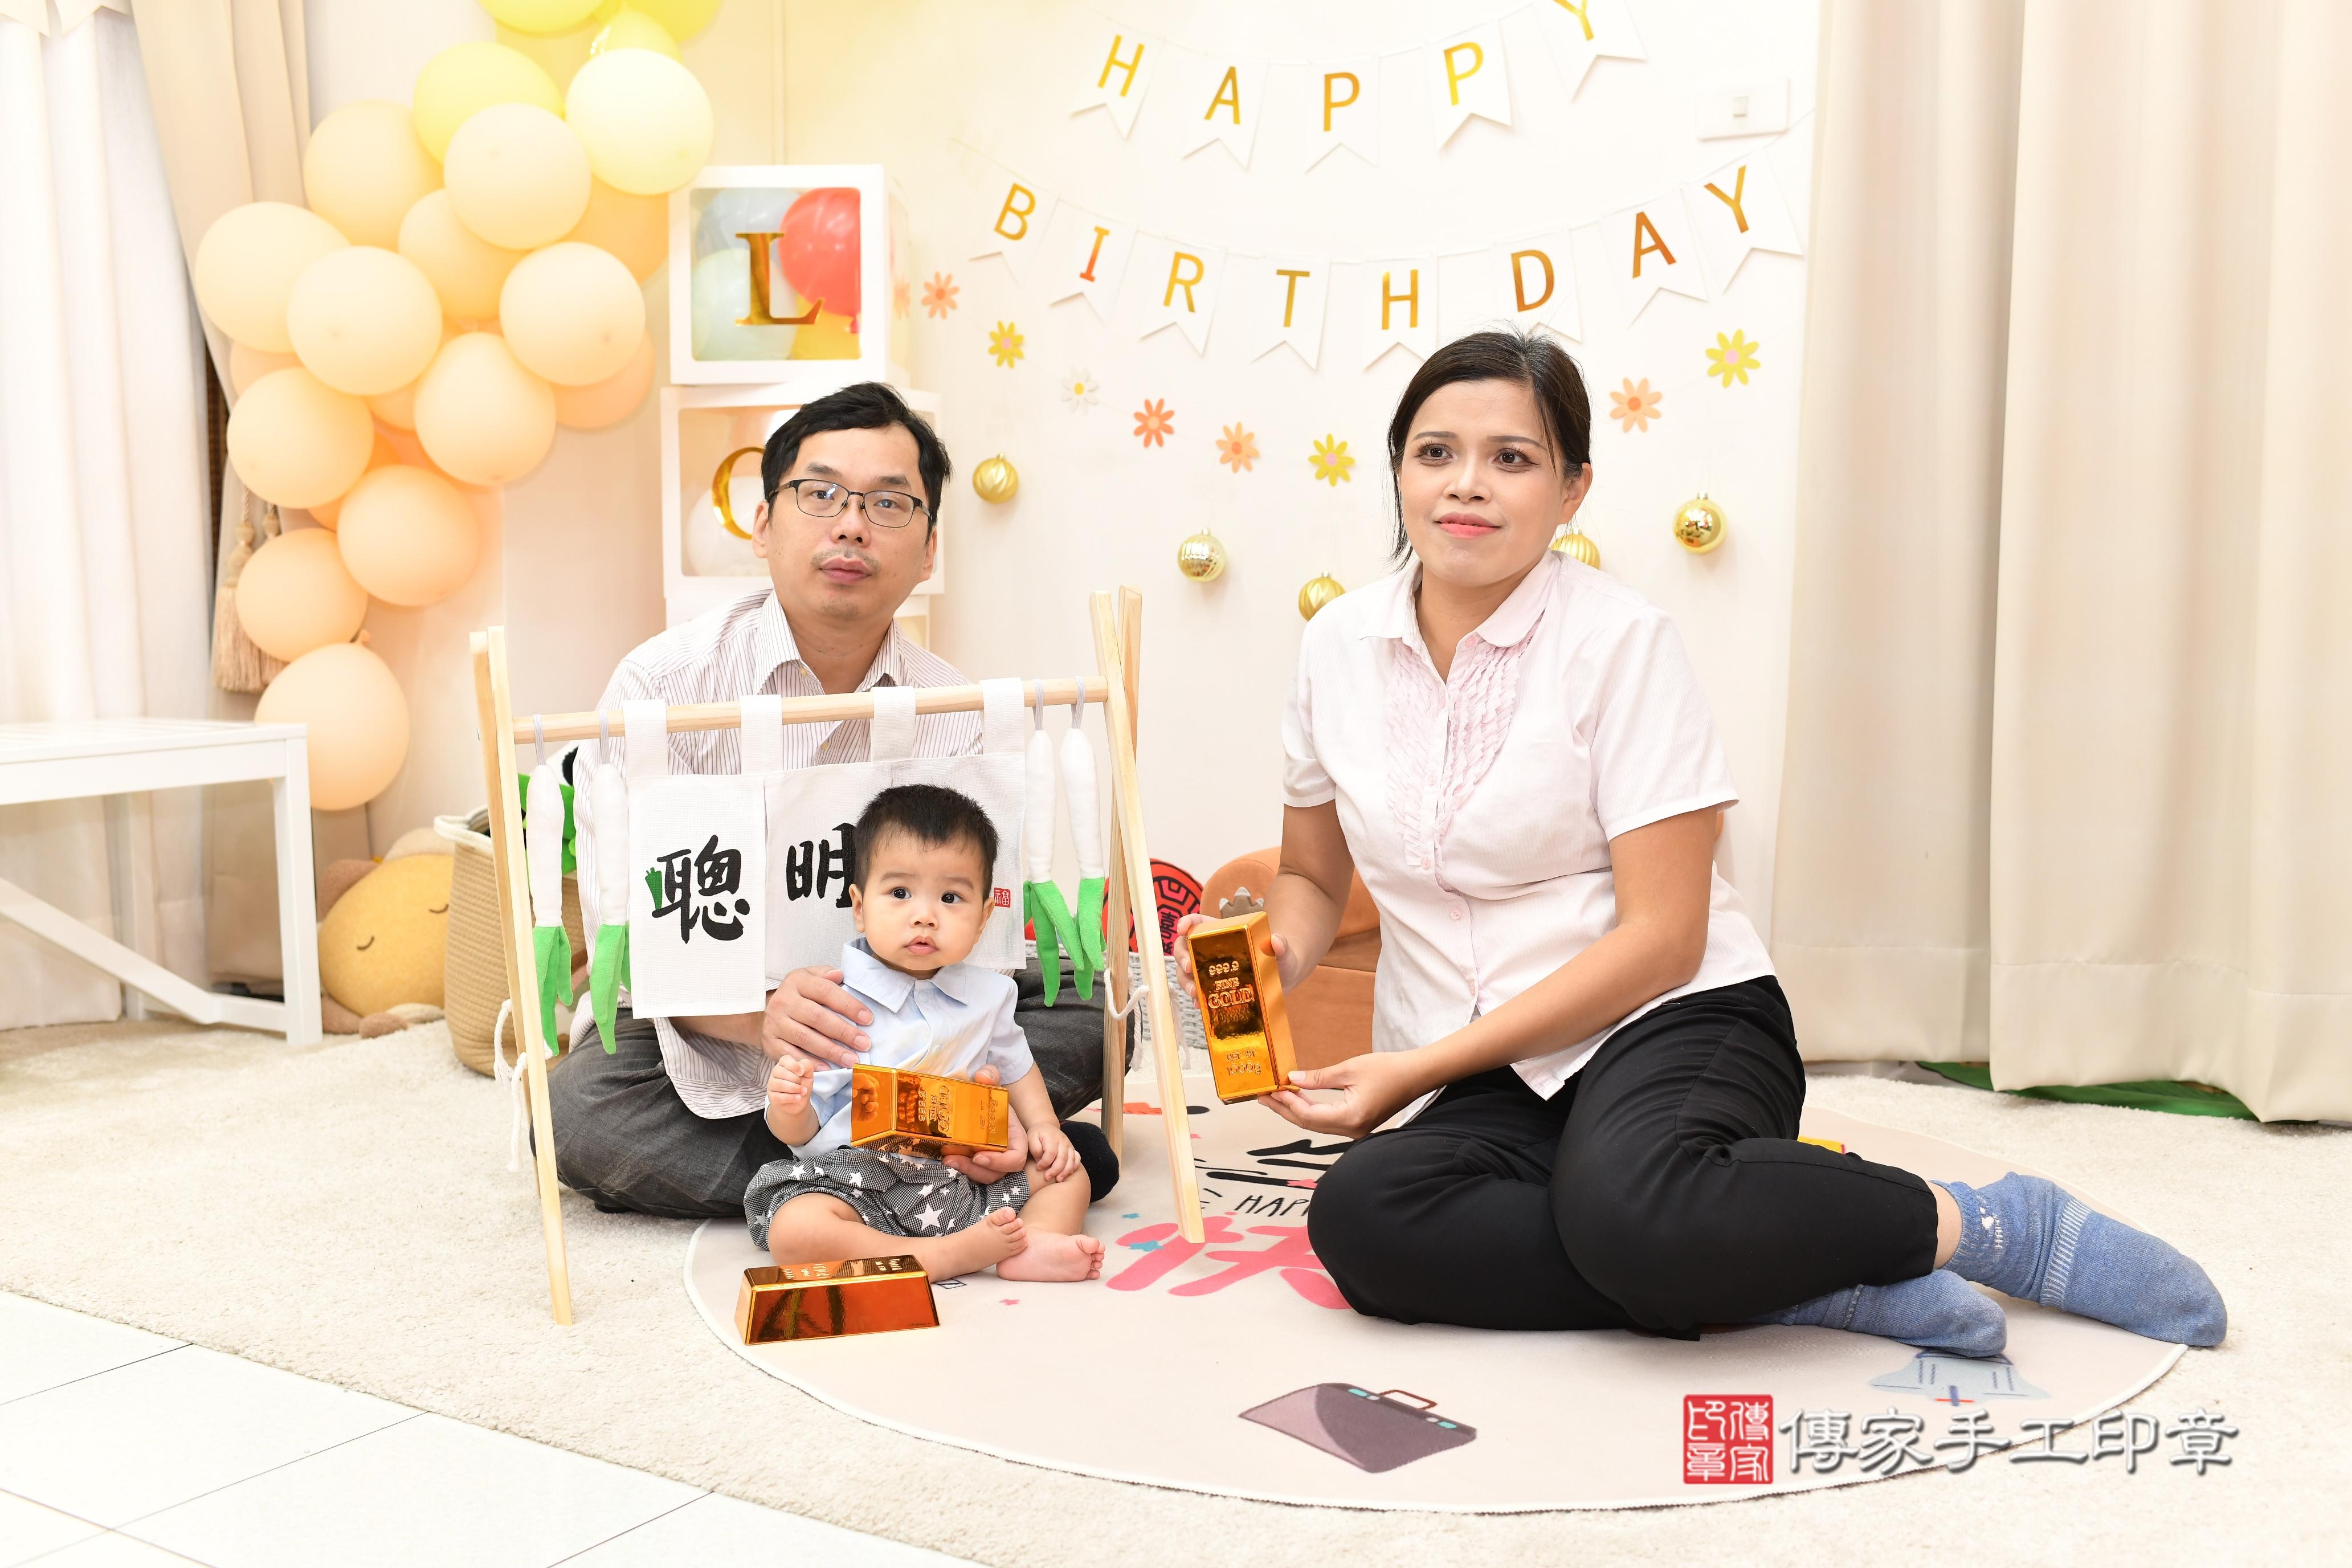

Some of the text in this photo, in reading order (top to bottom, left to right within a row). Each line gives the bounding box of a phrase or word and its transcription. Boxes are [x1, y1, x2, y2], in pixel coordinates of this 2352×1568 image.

[1097, 0, 1594, 132] HAPPY
[994, 166, 1747, 330] BIRTHDAY
[735, 232, 824, 325] L
[1208, 961, 1239, 975] 999.9
[1214, 977, 1240, 991] FINE
[1208, 987, 1254, 1009] GOLD
[1226, 1049, 1256, 1061] NET WT
[1226, 1061, 1262, 1075] 1000g
[1234, 1195, 1310, 1217] HAP
